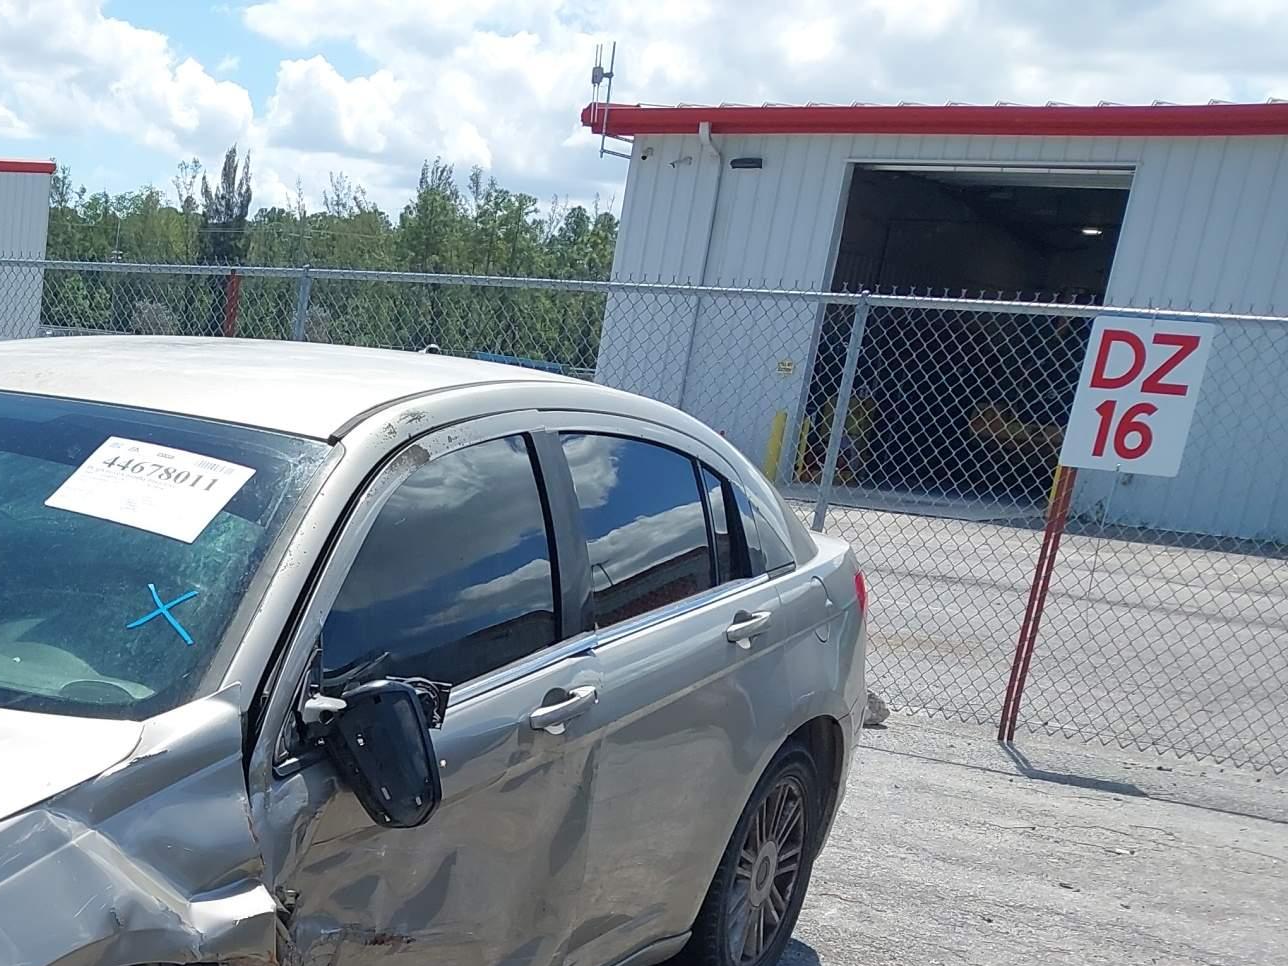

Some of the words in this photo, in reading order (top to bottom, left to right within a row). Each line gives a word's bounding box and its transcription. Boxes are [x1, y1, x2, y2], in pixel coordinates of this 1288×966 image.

[1090, 329, 1201, 396] DZ
[1091, 400, 1158, 461] 16
[102, 454, 220, 492] 44678011
